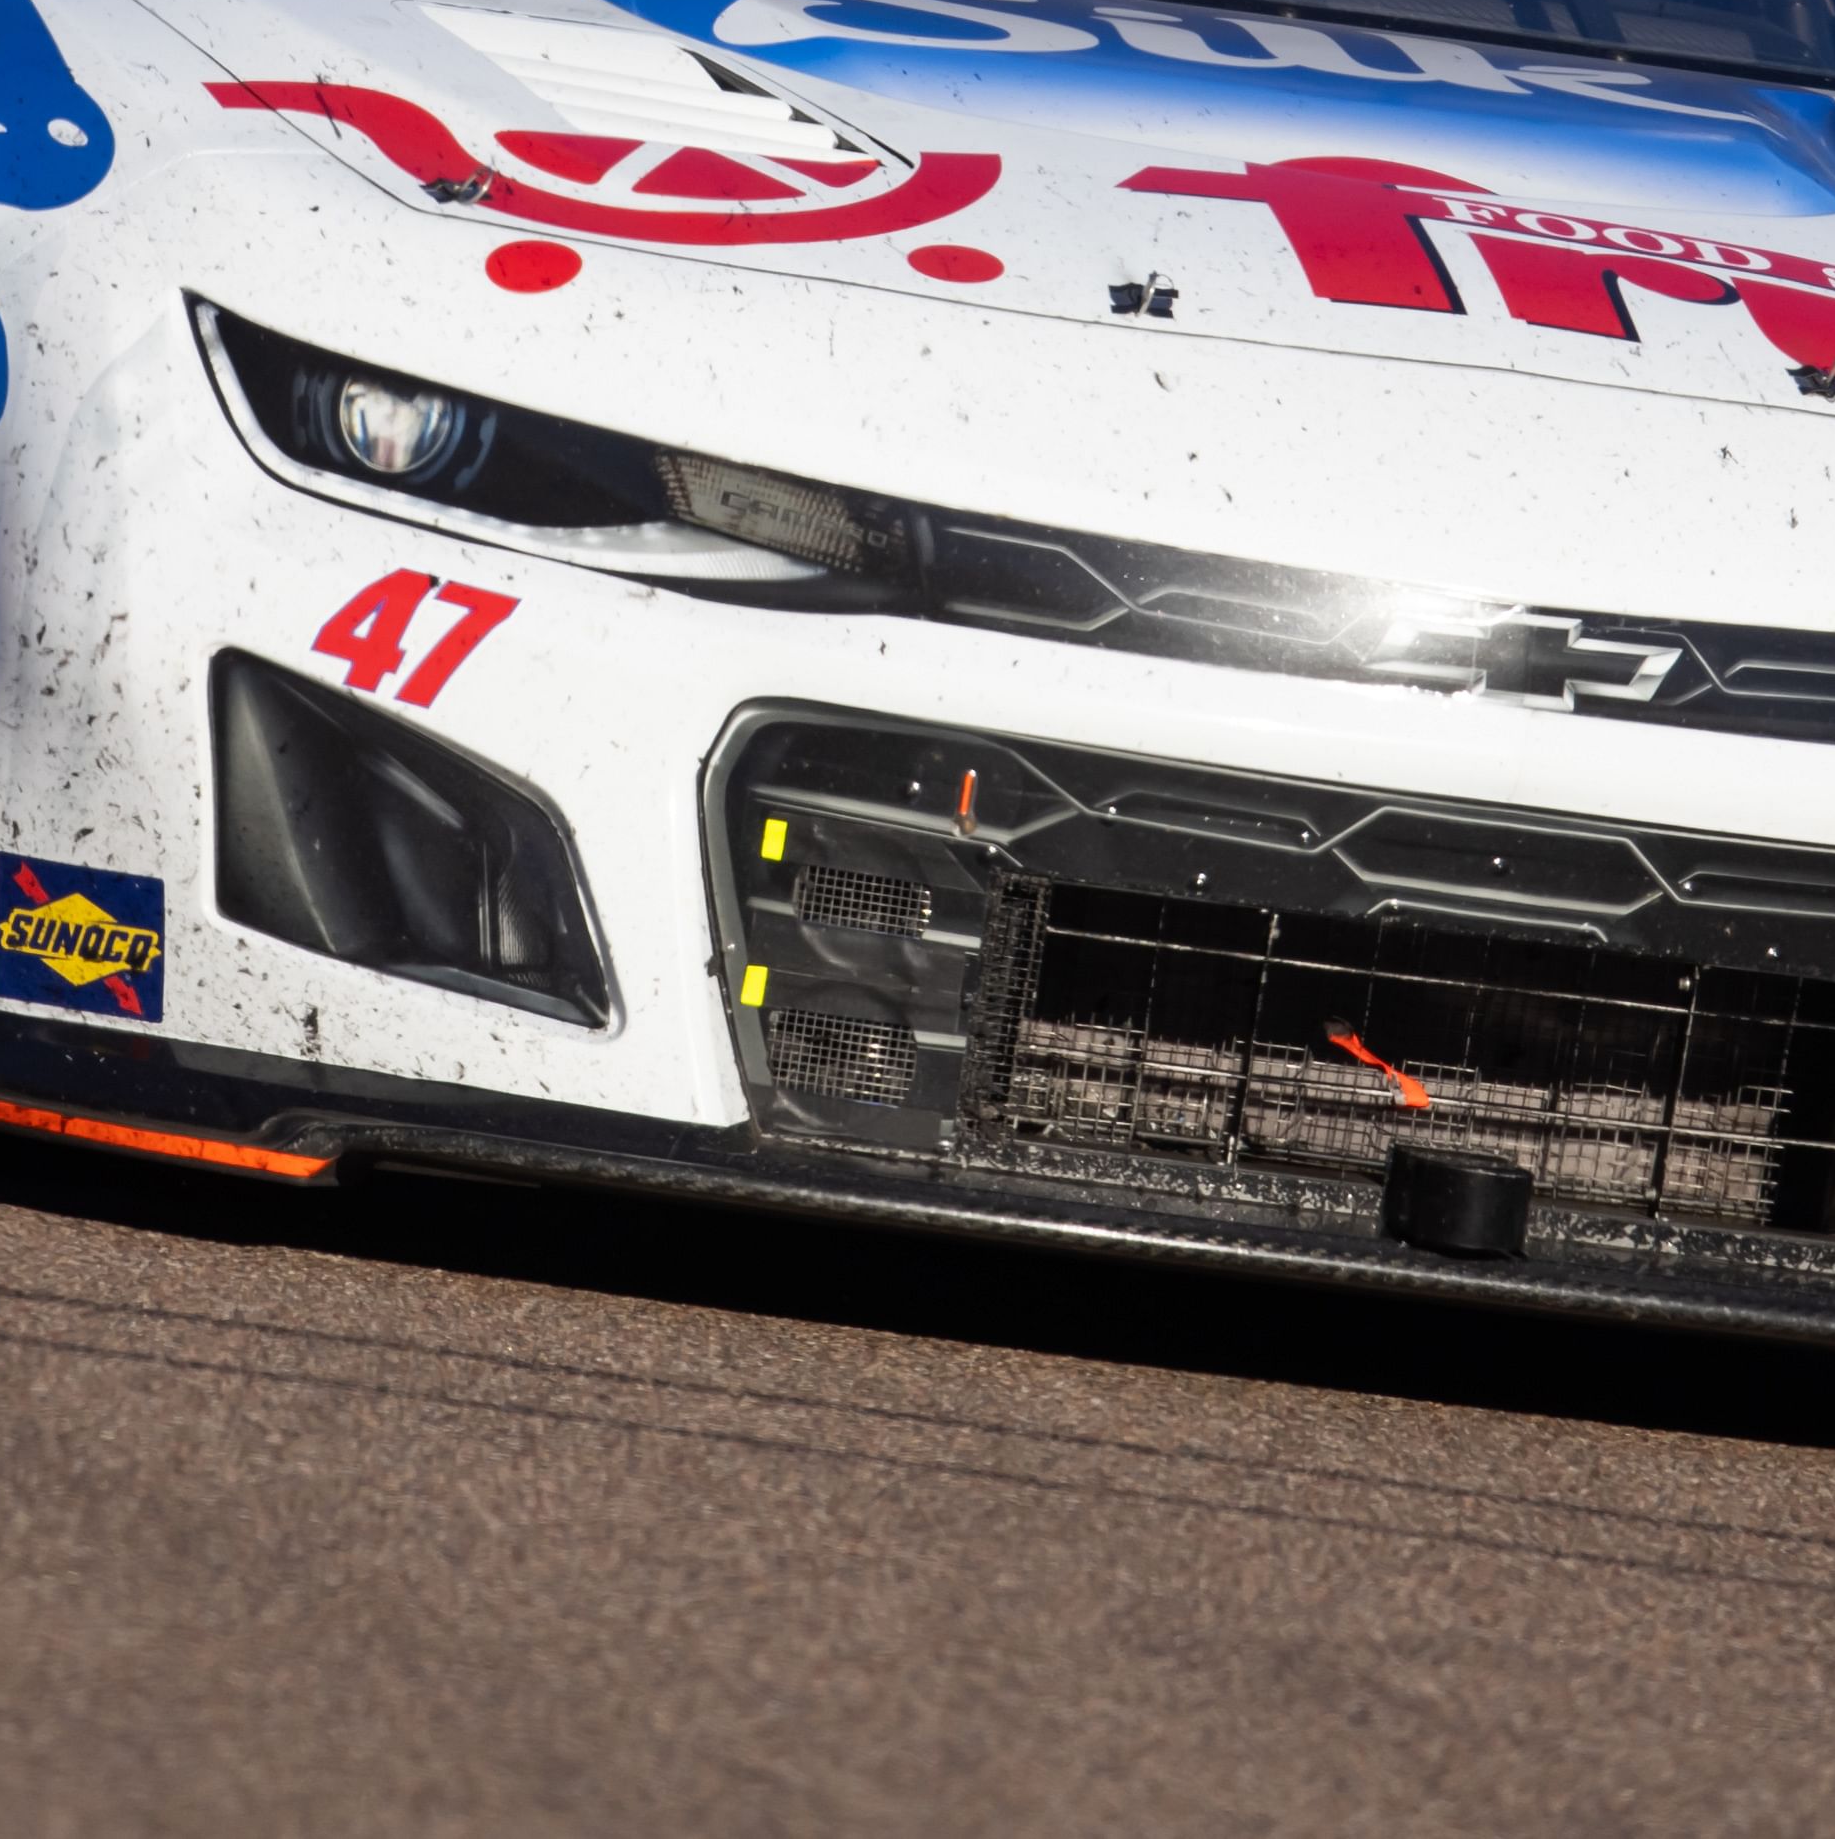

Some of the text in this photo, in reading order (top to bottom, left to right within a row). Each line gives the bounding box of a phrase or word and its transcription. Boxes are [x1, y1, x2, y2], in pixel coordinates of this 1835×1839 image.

[1431, 196, 1773, 272] FOOD
[310, 567, 522, 709] 47
[5, 913, 153, 970] SUNOCO
